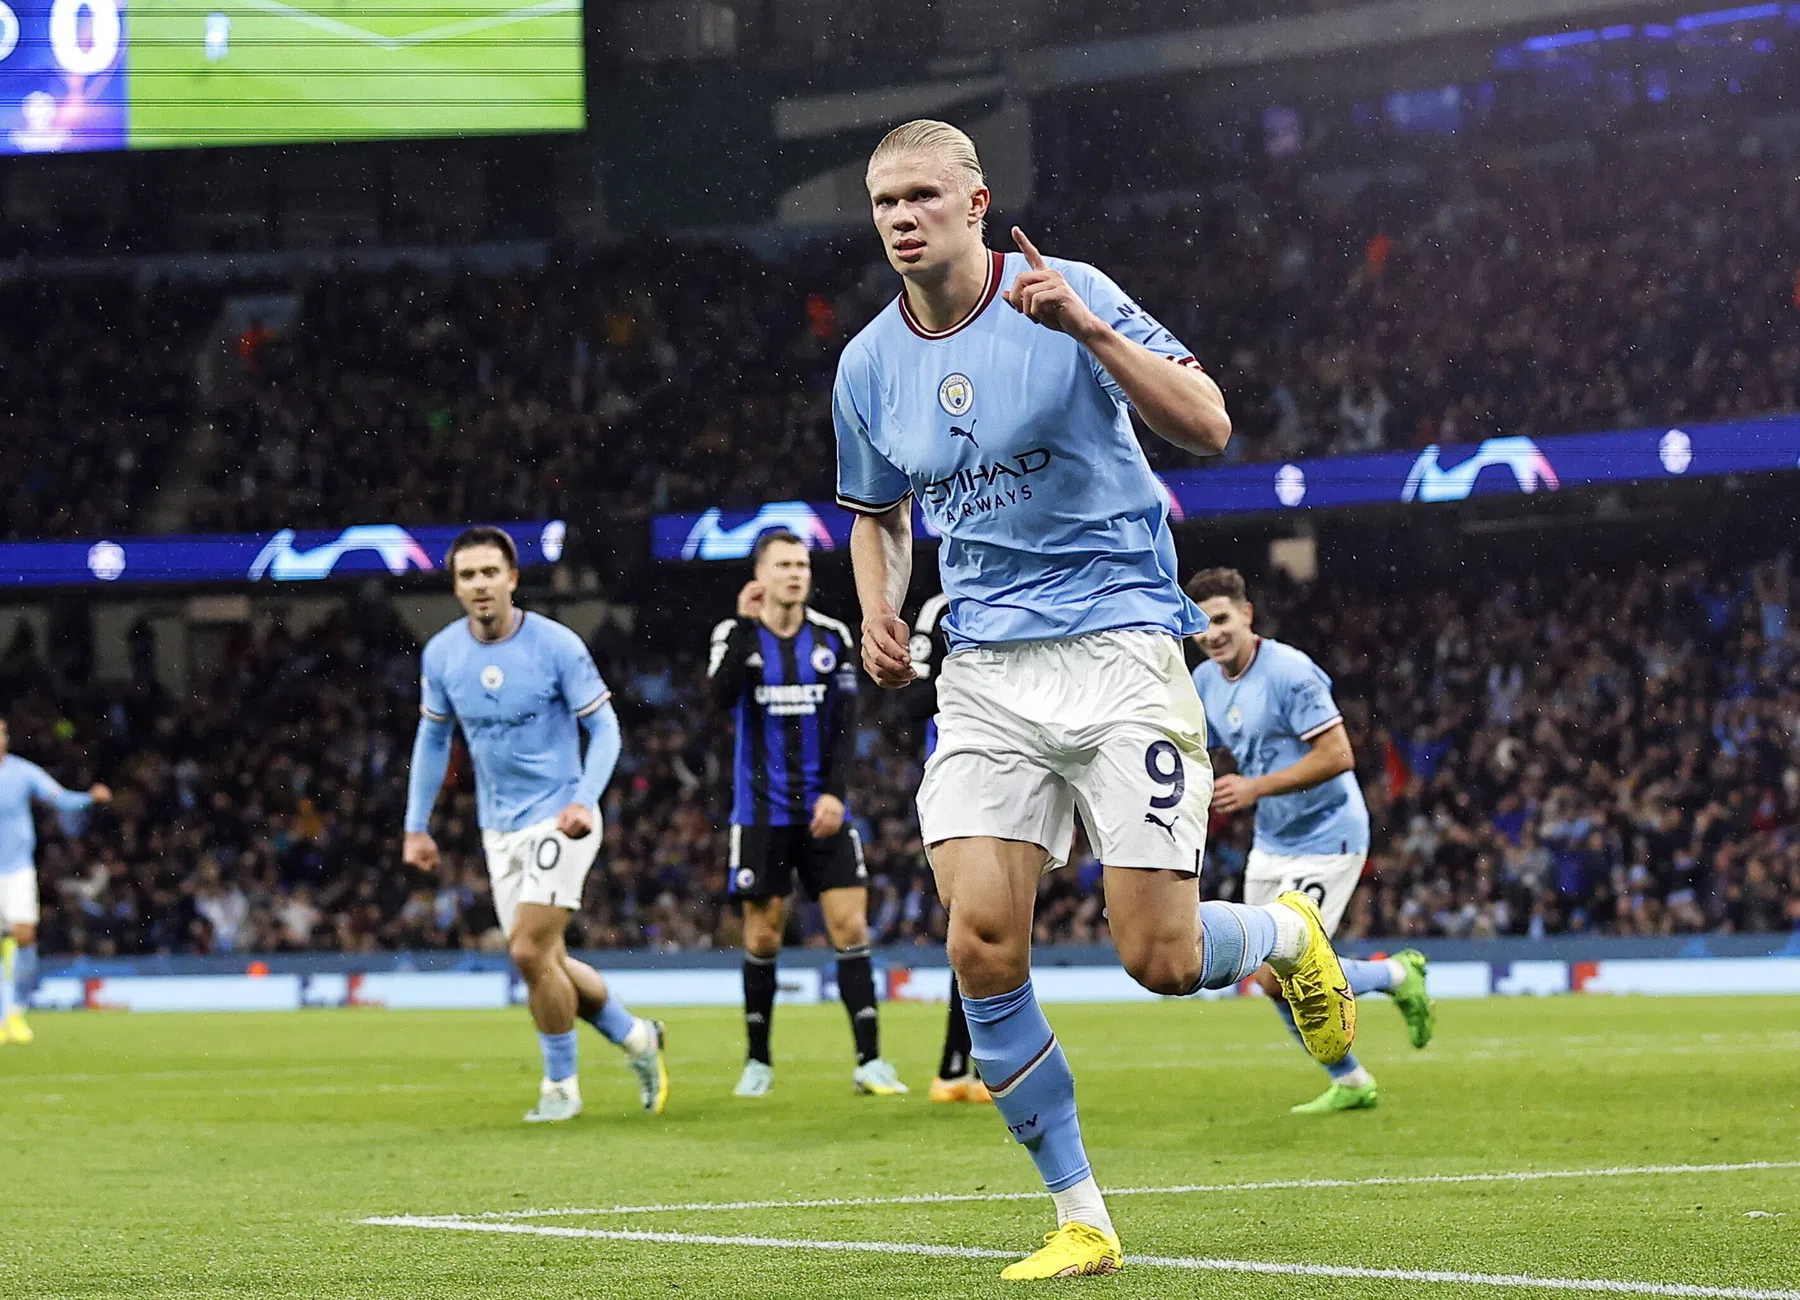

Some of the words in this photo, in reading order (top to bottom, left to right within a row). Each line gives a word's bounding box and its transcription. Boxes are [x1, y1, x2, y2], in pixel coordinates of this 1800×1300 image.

[924, 447, 1051, 504] ETIHAD
[946, 484, 1033, 523] ARWAYS
[1144, 740, 1185, 809] 9
